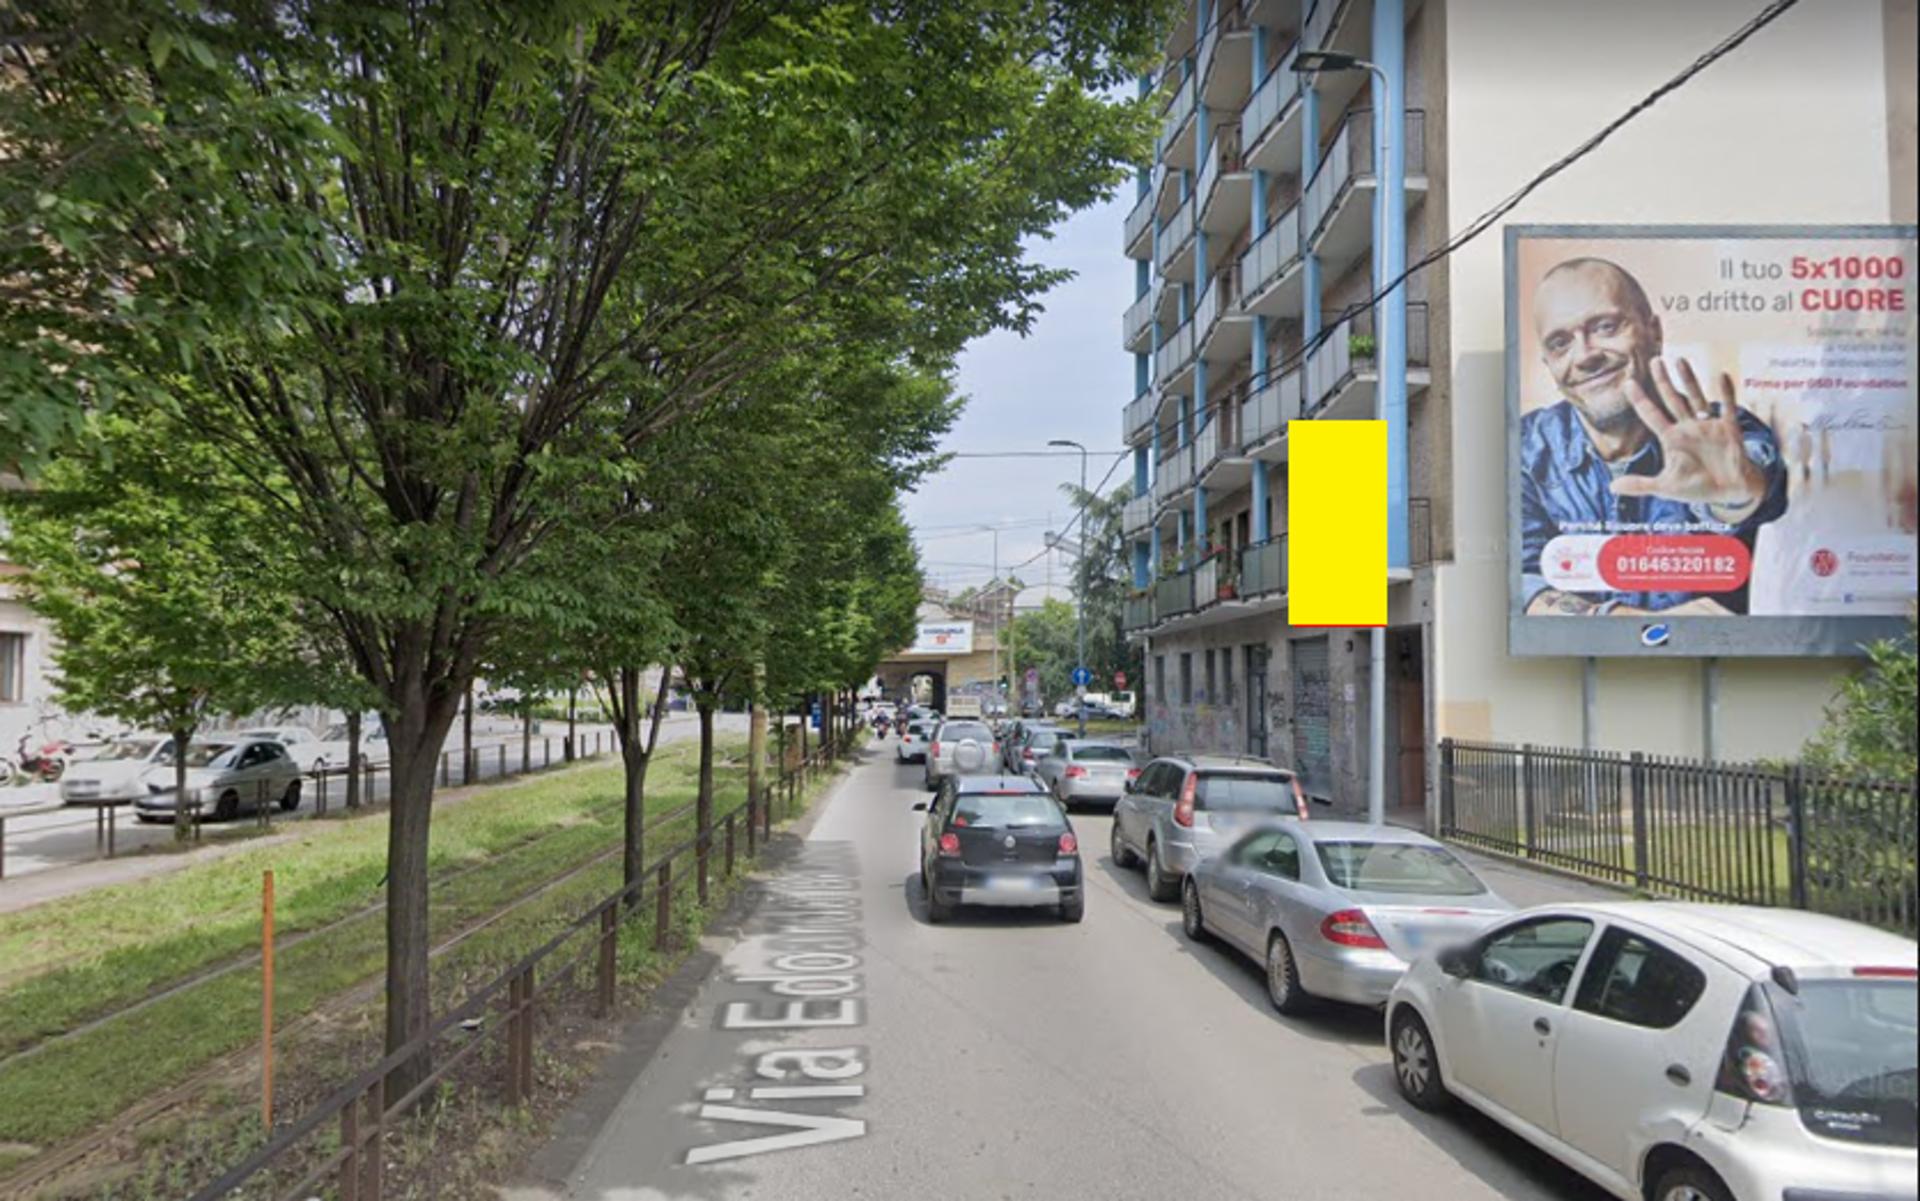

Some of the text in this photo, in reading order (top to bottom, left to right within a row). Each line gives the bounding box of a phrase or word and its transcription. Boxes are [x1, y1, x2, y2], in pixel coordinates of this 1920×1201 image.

[1720, 256, 1904, 280] Il tuo 5x1000
[1660, 288, 1906, 312] va dritto al CUORE
